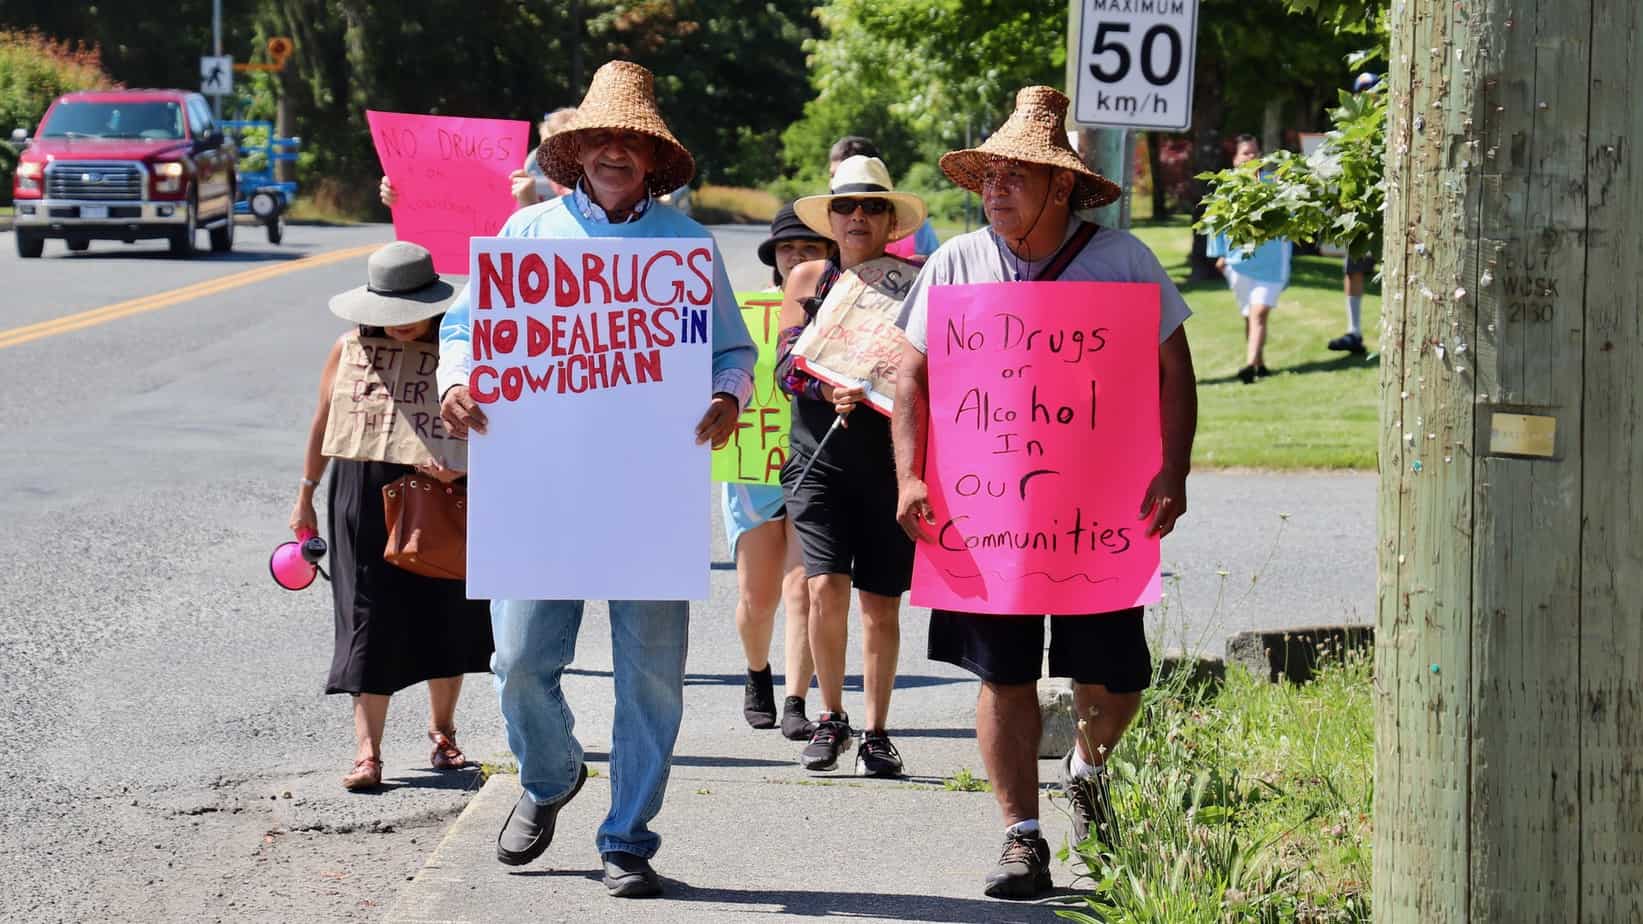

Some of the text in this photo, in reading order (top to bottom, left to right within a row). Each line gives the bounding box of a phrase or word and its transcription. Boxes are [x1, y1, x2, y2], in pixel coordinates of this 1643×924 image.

[1094, 0, 1184, 14] MAXIMUM
[1089, 21, 1182, 86] 50
[1097, 91, 1168, 114] km/h
[380, 127, 513, 161] NO DRUGS
[472, 319, 518, 361] NO
[526, 307, 680, 357] DEALERS
[946, 314, 984, 356] No
[995, 313, 1112, 363] Drugs
[1001, 365, 1032, 379] or
[349, 410, 396, 436] THE
[954, 380, 1097, 432] Alcohol
[991, 433, 1044, 456] In
[938, 507, 1132, 555] Communities
